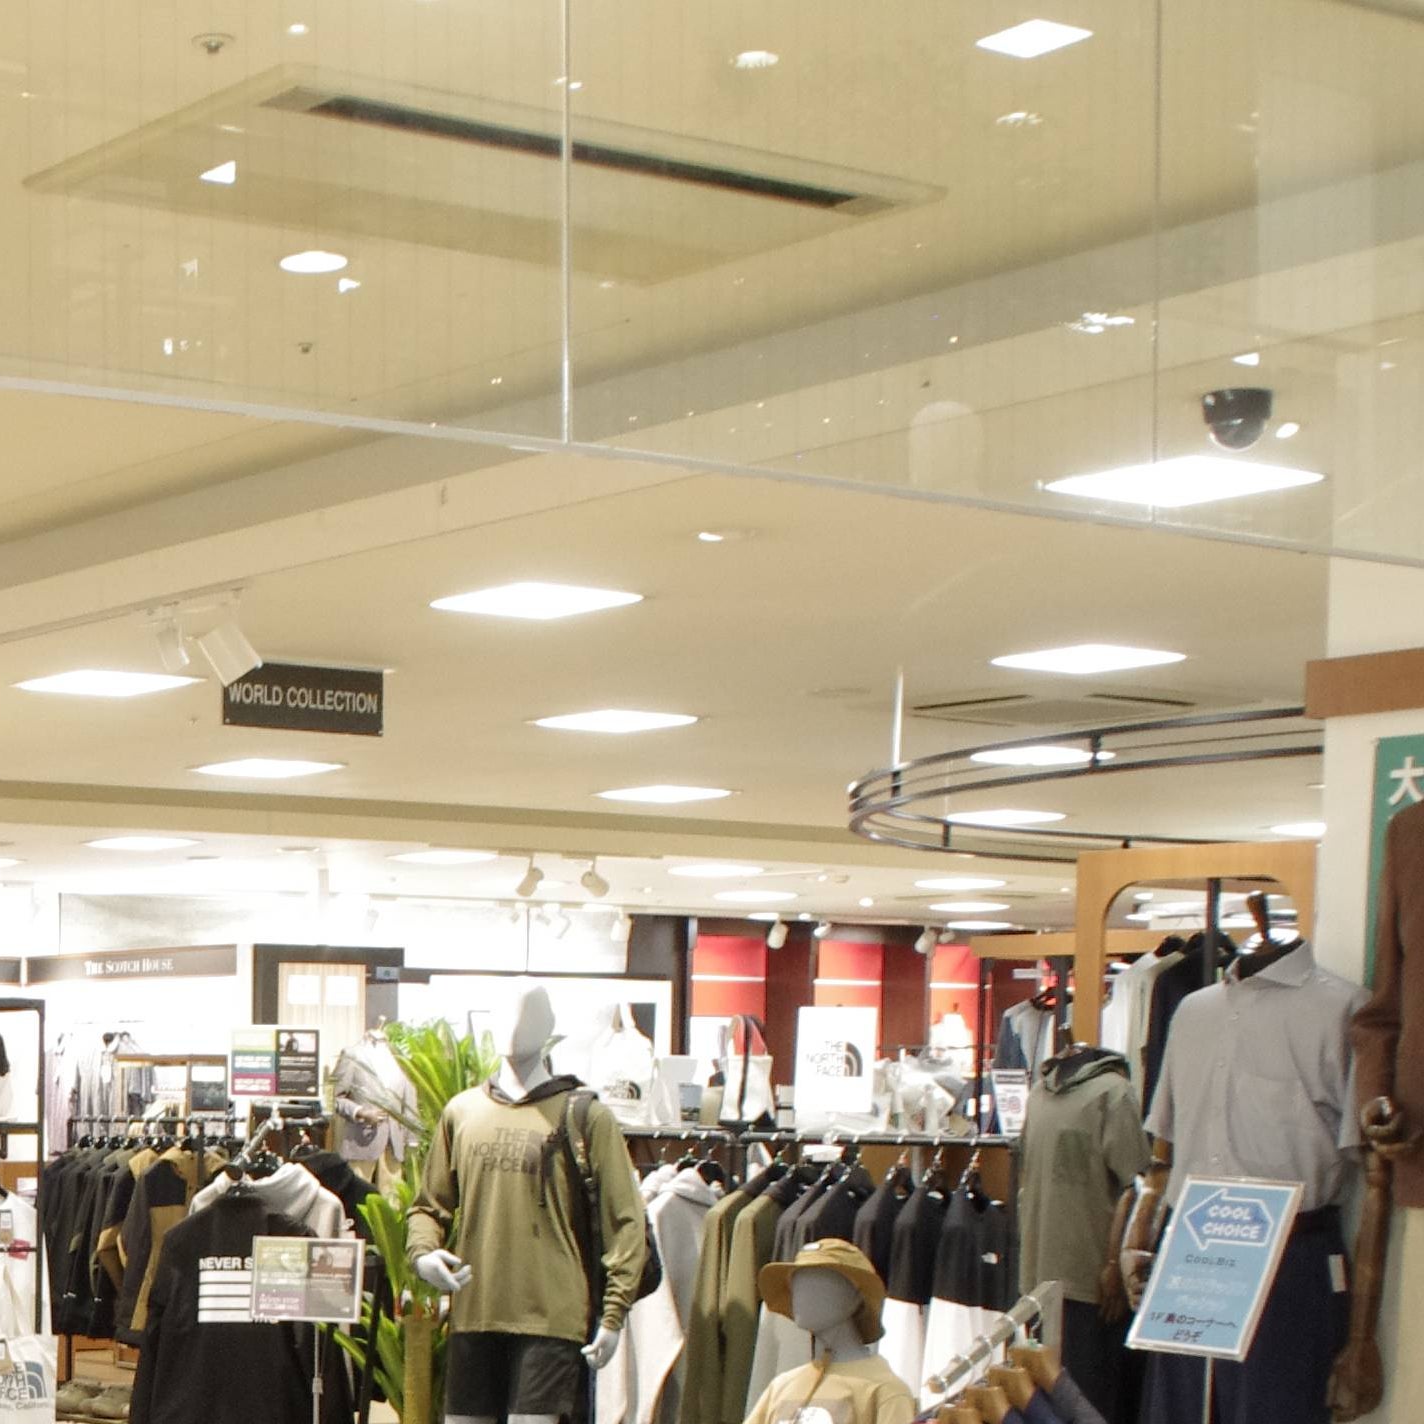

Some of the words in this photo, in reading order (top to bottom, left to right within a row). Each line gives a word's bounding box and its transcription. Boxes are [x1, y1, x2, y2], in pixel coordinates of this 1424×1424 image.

[229, 683, 282, 706] WORLD
[286, 686, 378, 713] COLLECTION
[84, 960, 104, 976] THE
[142, 958, 174, 973] HOUSE
[824, 1040, 843, 1052] THE
[806, 1052, 843, 1064] NORTH
[817, 1065, 843, 1077] FACE
[495, 1127, 528, 1141] THE
[472, 1141, 526, 1157] NORTH
[482, 1157, 522, 1173] FACE
[1208, 1204, 1252, 1221] COOL
[1201, 1222, 1262, 1239] CHOICE
[199, 1256, 240, 1270] NEVER
